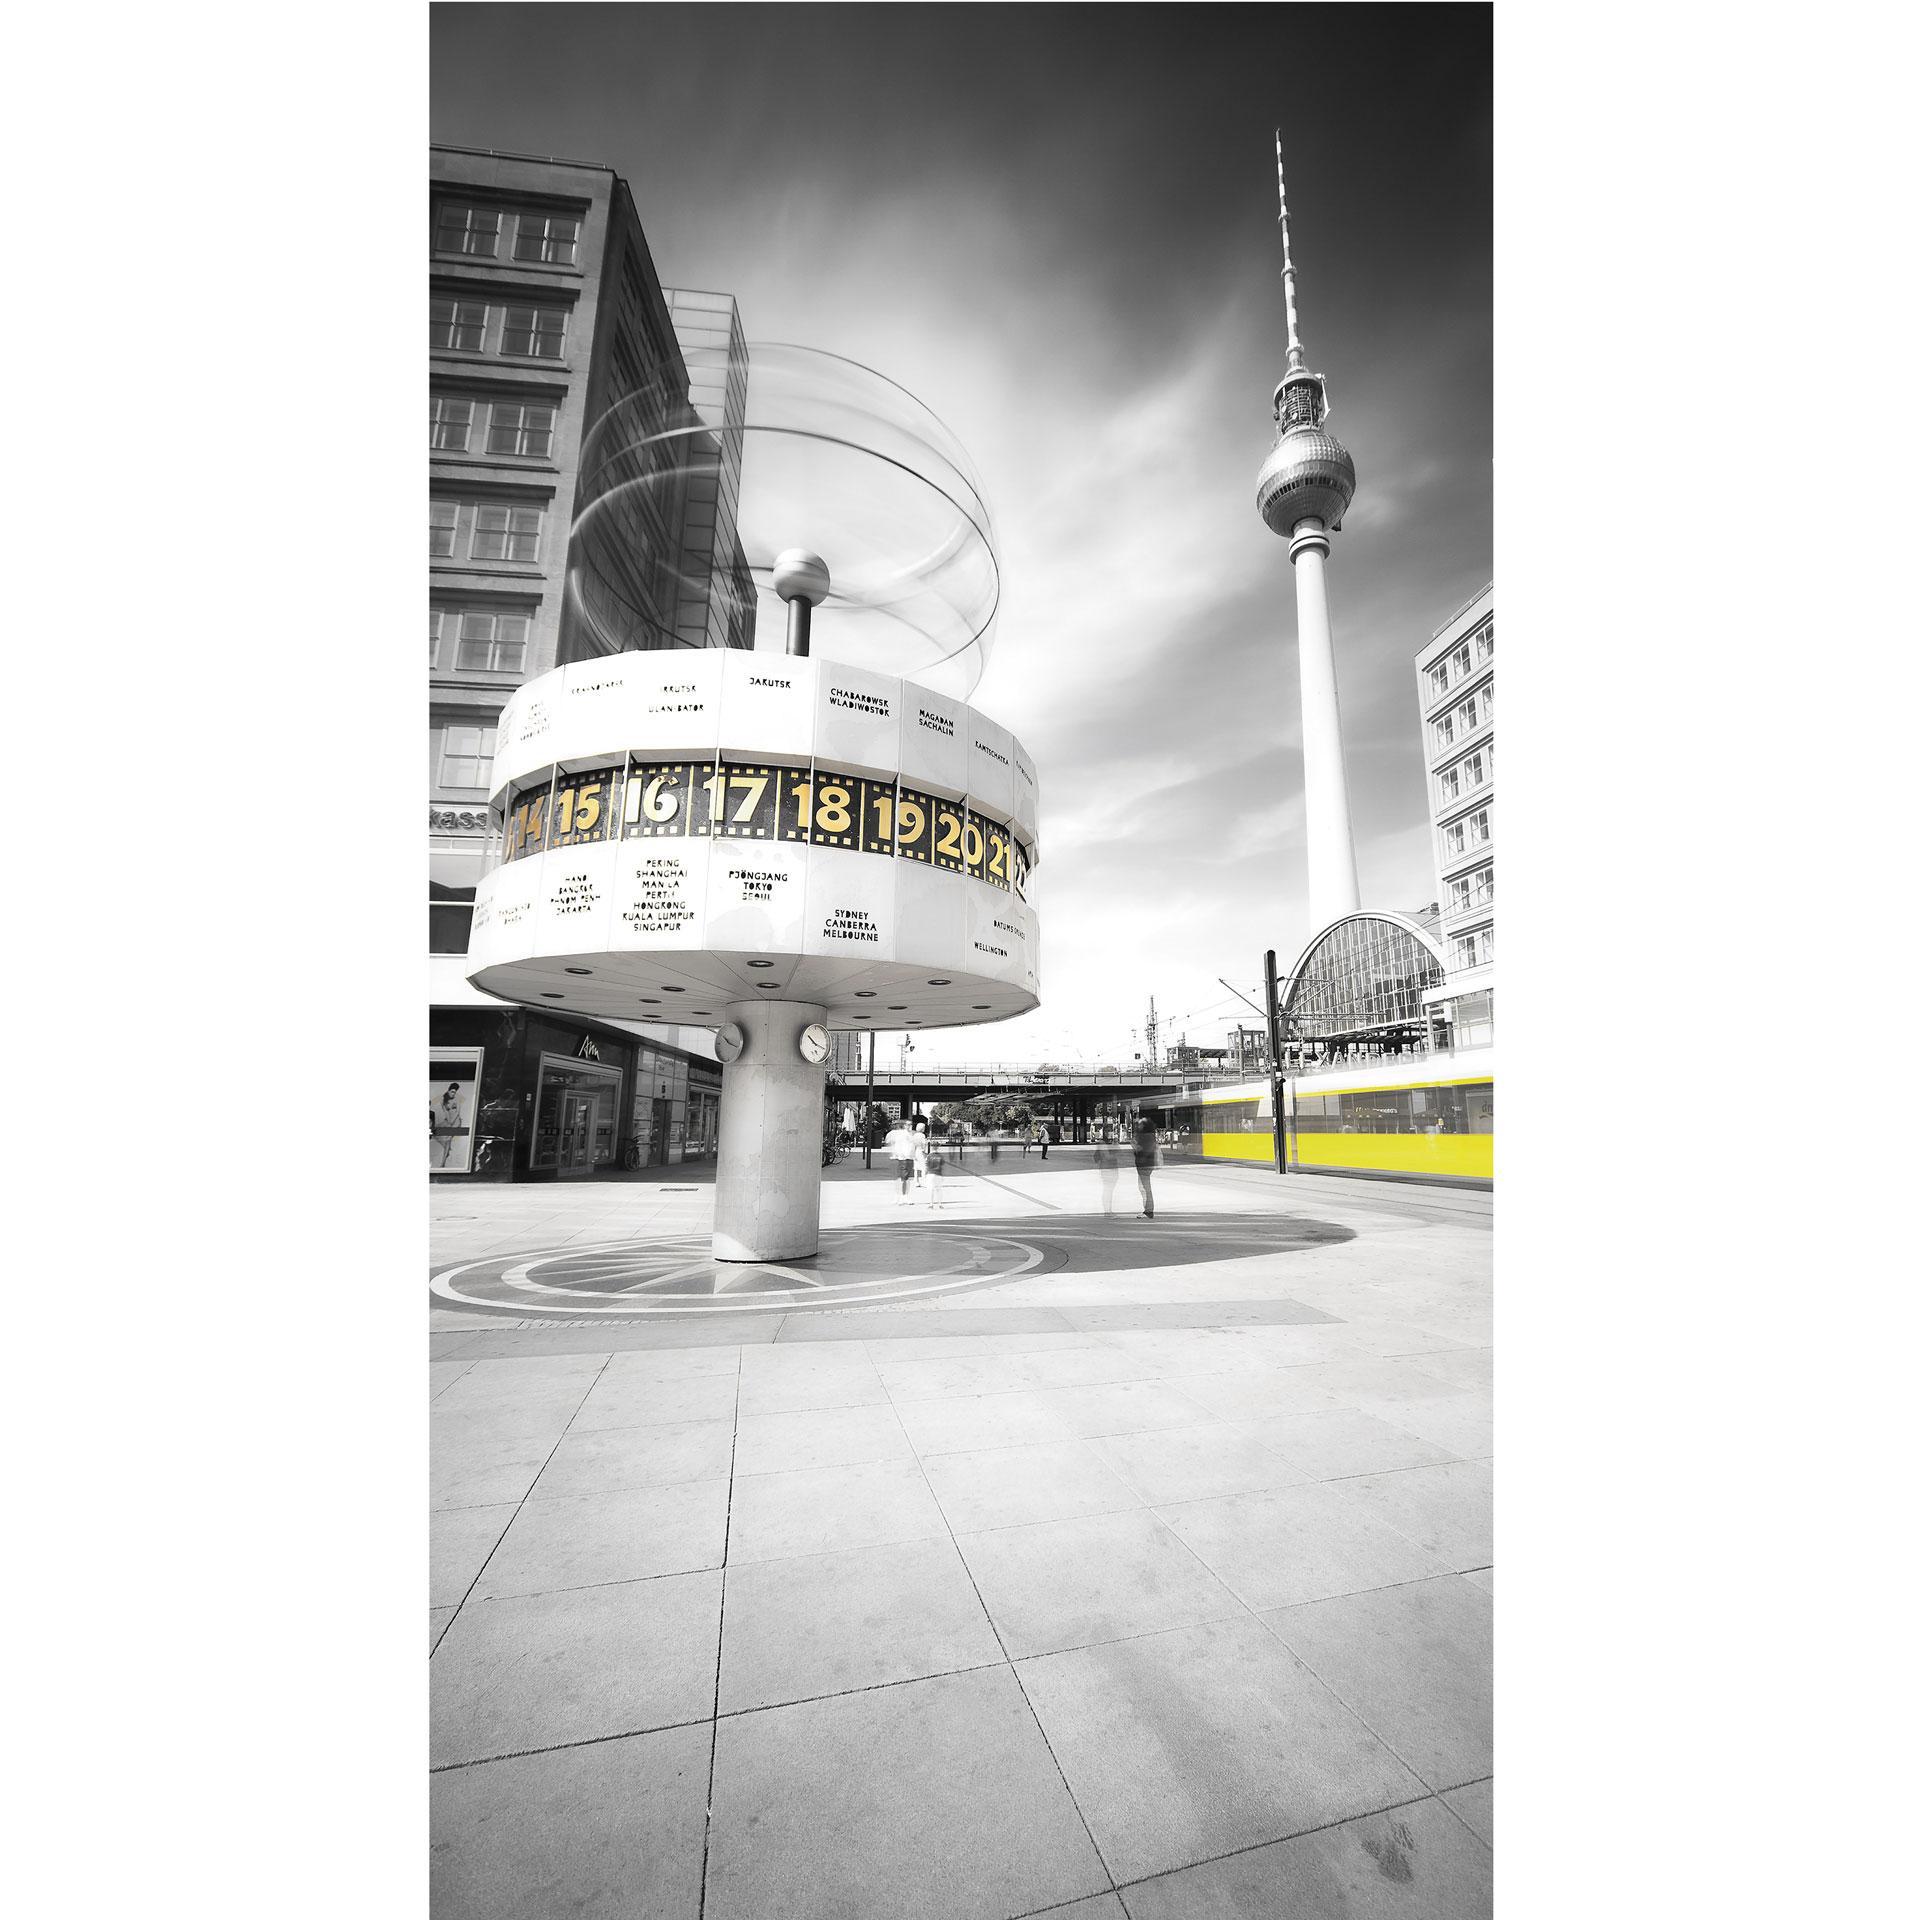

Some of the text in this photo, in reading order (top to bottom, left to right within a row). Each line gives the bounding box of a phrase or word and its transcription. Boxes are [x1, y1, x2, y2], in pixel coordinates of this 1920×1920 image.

[830, 688, 889, 707] CHABAROWSK
[829, 697, 889, 717] WLADIWOSTOK
[919, 709, 953, 729] MAGADAN
[919, 719, 953, 736] SACHALIN
[518, 795, 545, 848] 14
[559, 784, 600, 834] 15
[625, 775, 679, 823] 16
[703, 776, 768, 822] 17
[792, 783, 850, 832] 18
[873, 796, 925, 844] 19
[937, 812, 983, 866] 20
[989, 834, 1012, 882] 21
[636, 870, 687, 878] SHANGHAI
[728, 869, 788, 882] PJÖNGJANG
[743, 881, 772, 891] TOKYO
[634, 901, 685, 910] HONGKONG
[623, 912, 694, 921] KUALA LUMPUR
[835, 909, 868, 920] SYDNEY
[634, 923, 681, 931] SINGAPUR
[825, 919, 877, 931] CANBERRA
[823, 929, 878, 941] MELBOURNE
[974, 941, 1007, 957] WELLINGTON
